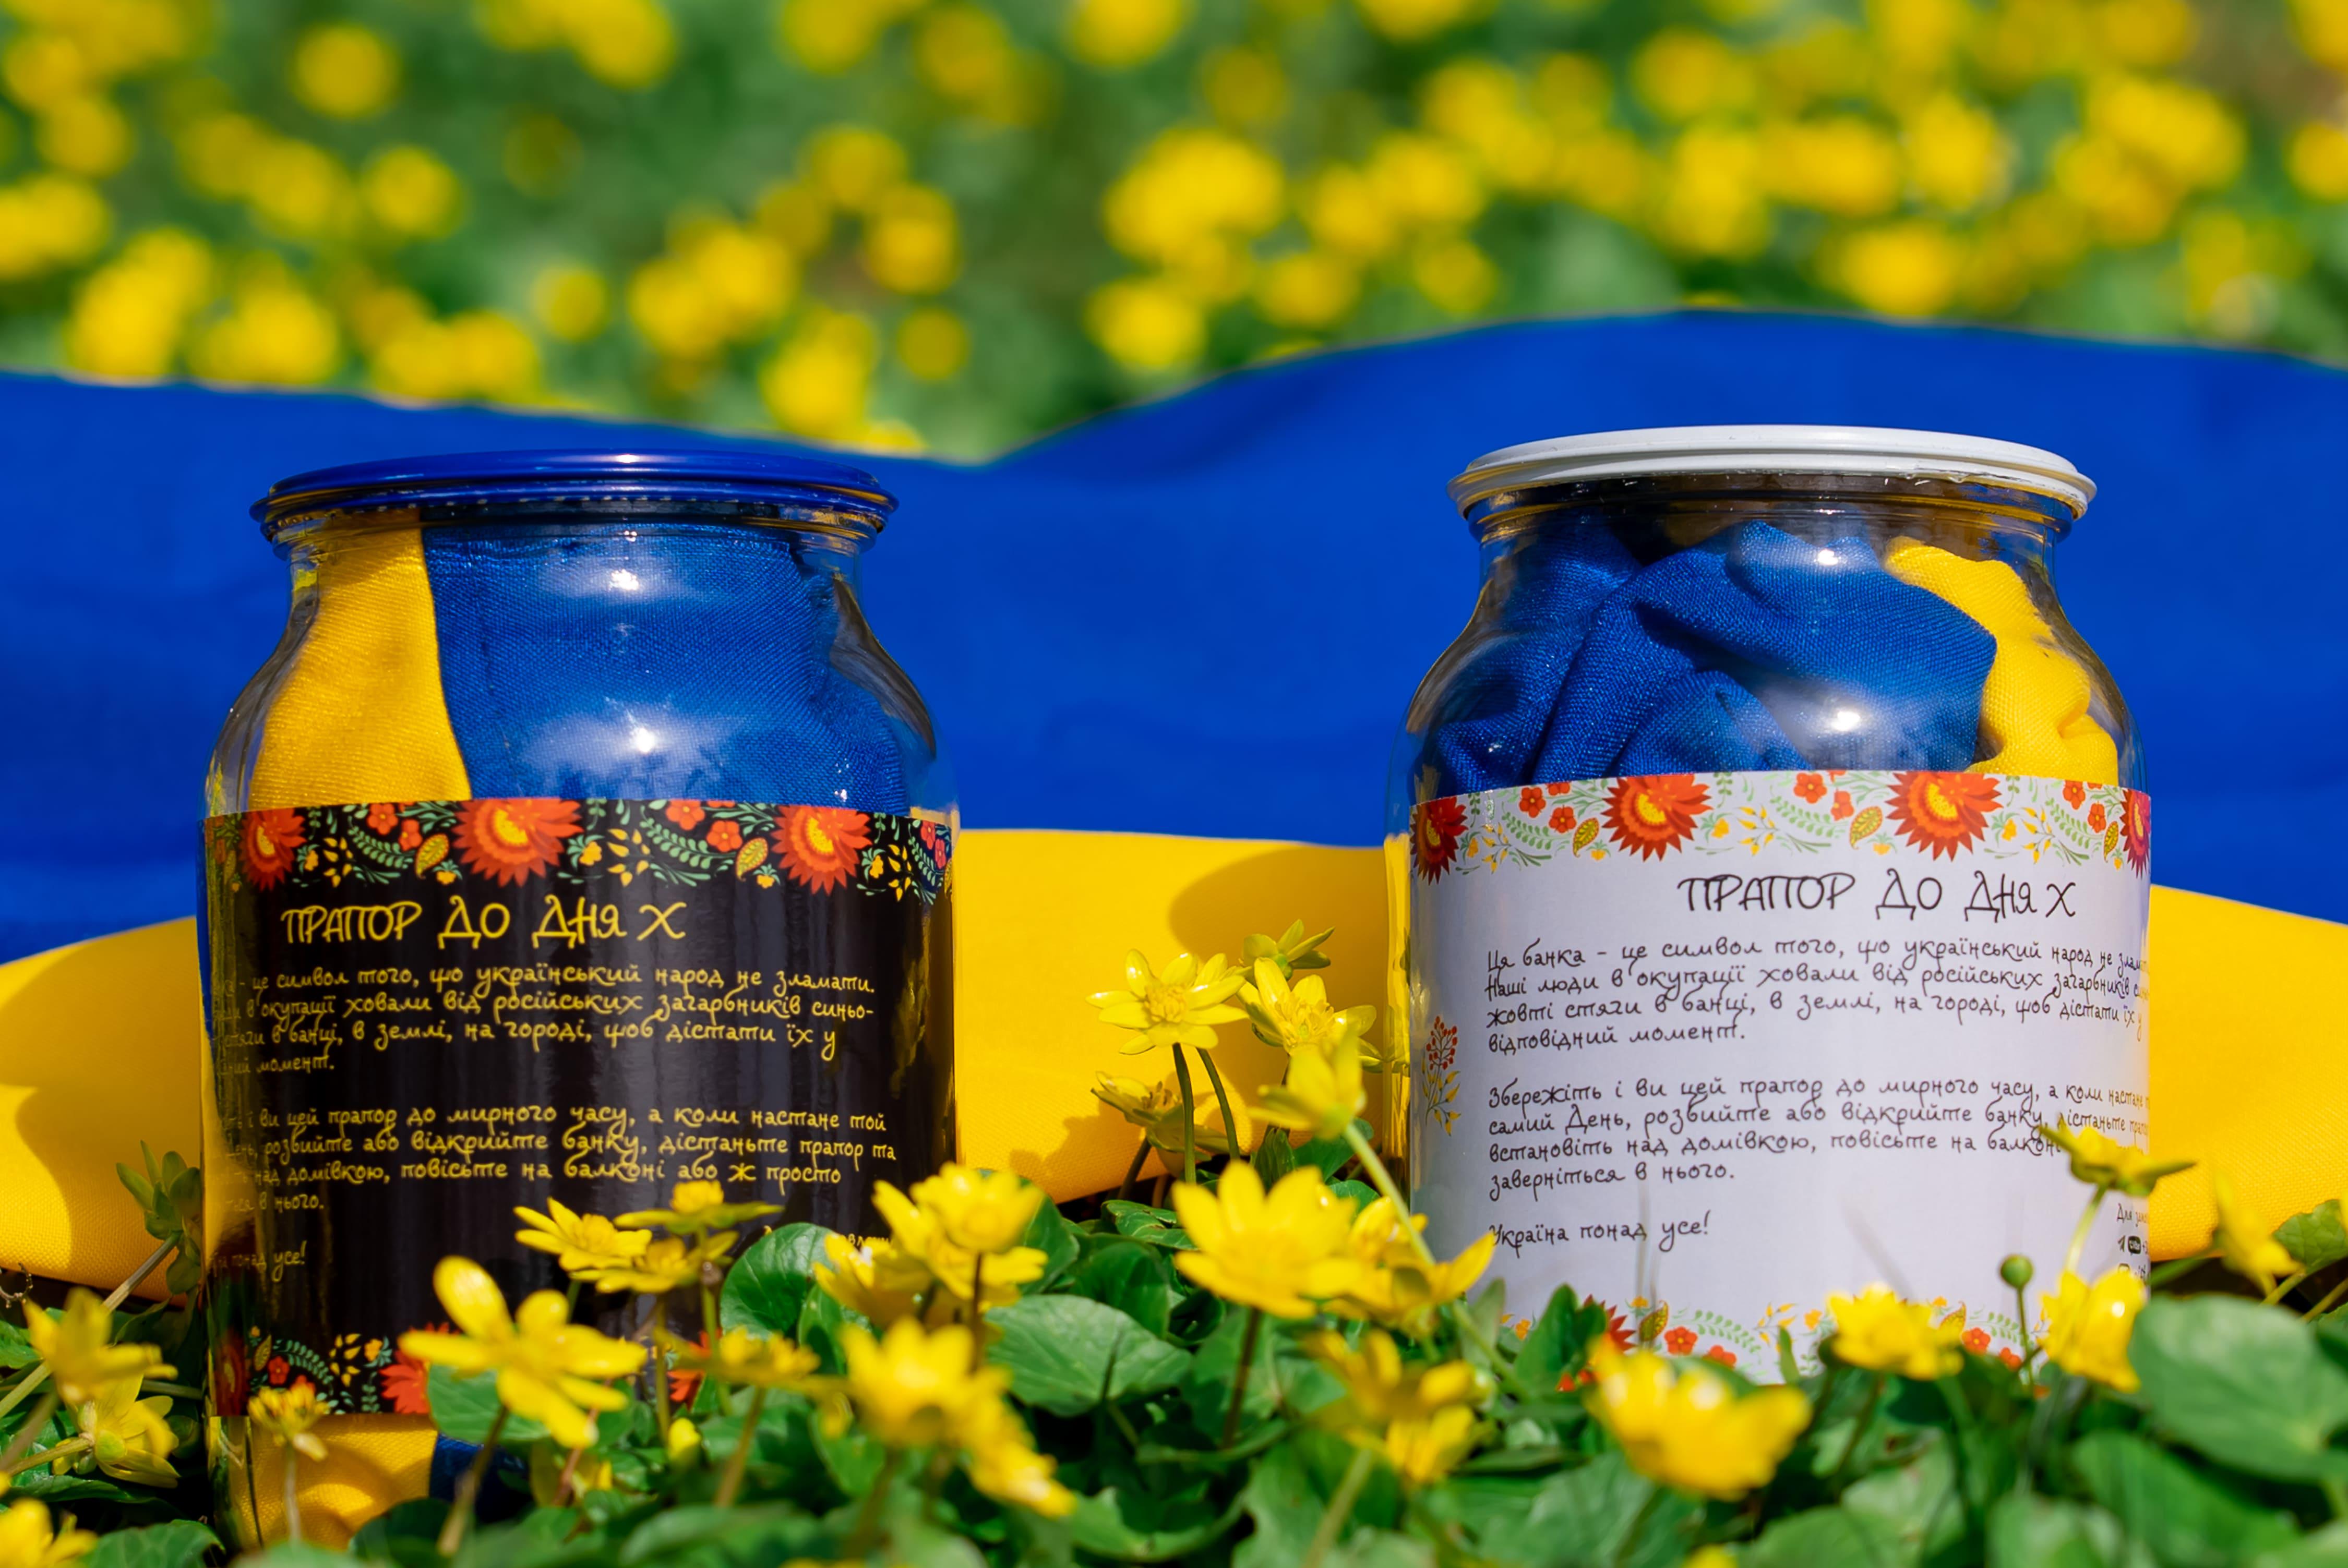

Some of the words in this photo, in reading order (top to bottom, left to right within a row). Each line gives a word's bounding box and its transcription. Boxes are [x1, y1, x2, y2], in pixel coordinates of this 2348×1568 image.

[1678, 873, 1855, 911] ПРАПОР
[1876, 867, 1943, 920] ДО
[2046, 882, 2076, 918] Х
[281, 901, 422, 944] ПРАПОР
[437, 895, 510, 949] ДО
[637, 902, 687, 941] Х
[1488, 950, 1515, 983] Ця
[1523, 937, 1586, 968] банка
[1621, 946, 1648, 975] це
[1662, 936, 1762, 958] символ
[1774, 938, 1844, 959] того,
[1858, 940, 1890, 963] що
[1904, 938, 2042, 971] український
[2052, 945, 2093, 974] народ
[2100, 951, 2113, 969] не
[253, 977, 269, 1006] це
[276, 967, 349, 988] символ
[357, 968, 419, 987] того,
[429, 969, 463, 993] що
[476, 963, 641, 999] український
[655, 968, 724, 998] народ
[737, 970, 762, 990] не
[773, 970, 874, 997] зламати.
[1484, 974, 1526, 1002] Наші
[1537, 975, 1599, 994] люди
[1611, 968, 1624, 987] в
[1636, 965, 1745, 1002] окупації
[1756, 963, 1859, 987] ховали
[1873, 963, 1909, 984] від
[1922, 966, 2043, 996] російських
[2054, 965, 2129, 1005] загарбників
[261, 995, 335, 1032] окупації
[342, 994, 432, 1018] ховали
[443, 991, 480, 1014] від
[493, 989, 643, 1024] російських
[658, 983, 801, 1026] загарбників
[811, 1002, 873, 1022] синьо-
[1487, 1002, 1553, 1029] жовті
[1565, 1000, 1642, 1018] стяги
[1655, 994, 1667, 1012] в
[1682, 985, 1756, 1025] банці,
[1770, 991, 1782, 1010] в
[1796, 992, 1880, 1020] землі,
[1894, 994, 1922, 1011] на
[1934, 994, 2006, 1024] городі,
[2016, 986, 2057, 1023] щоб
[2059, 999, 2119, 1021] дістати
[2123, 1005, 2135, 1028] їх
[271, 1024, 281, 1043] в
[289, 1015, 343, 1056] банці,
[352, 1020, 365, 1041] в
[373, 1020, 453, 1051] землі,
[464, 1021, 495, 1039] на
[503, 1019, 592, 1053] городі,
[604, 1009, 663, 1047] щоб
[666, 1020, 776, 1042] дістати
[786, 1024, 813, 1047] їх
[821, 1029, 836, 1062] у
[1488, 1026, 1618, 1056] відповідний
[1629, 1024, 1745, 1043] момент.
[257, 1055, 334, 1074] момент.
[1489, 1077, 1602, 1119] Збережіть
[1615, 1081, 1623, 1098] і
[1636, 1078, 1667, 1097] ви
[1680, 1077, 1727, 1106] цей
[1740, 1079, 1823, 1107] прапор
[1836, 1078, 1865, 1096] до
[1879, 1079, 1979, 1107] мирного
[1991, 1081, 2040, 1111] часу,
[2049, 1085, 2059, 1099] а
[2066, 1084, 2103, 1104] коли
[1489, 1113, 1555, 1135] самий
[1565, 1103, 1631, 1133] День,
[1644, 1093, 1770, 1139] розбийте
[1786, 1096, 1826, 1121] або
[1841, 1102, 1973, 1135] відкрийте
[259, 1108, 280, 1127] ви
[287, 1108, 319, 1136] цей
[328, 1108, 397, 1139] прапор
[406, 1107, 436, 1126] до
[447, 1105, 557, 1136] мирного
[570, 1106, 636, 1138] часу,
[648, 1109, 663, 1124] а
[674, 1107, 739, 1128] коли
[751, 1109, 840, 1131] настане
[850, 1113, 887, 1132] той
[265, 1126, 352, 1170] розбийте
[363, 1123, 399, 1151] або
[411, 1131, 548, 1163] відкрийте
[562, 1121, 647, 1166] банку,
[658, 1133, 788, 1154] дістаньте
[800, 1138, 864, 1171] прапор
[872, 1144, 896, 1161] та
[1488, 1138, 1613, 1163] встановіть
[1626, 1138, 1669, 1156] над
[1681, 1131, 1817, 1154] домівкою,
[1831, 1130, 1937, 1149] повісьте
[1951, 1136, 1976, 1153] на
[287, 1161, 390, 1185] домівкою,
[401, 1160, 508, 1179] повісьте
[522, 1162, 553, 1181] на
[563, 1149, 664, 1183] балконі
[678, 1150, 717, 1179] або
[727, 1164, 757, 1182] ж
[766, 1164, 841, 1196] просто
[1489, 1167, 1625, 1201] заверніться
[1635, 1162, 1647, 1180] в
[1662, 1164, 1734, 1184] нього.
[259, 1191, 267, 1210] в
[274, 1193, 325, 1213] нього.
[1488, 1223, 1569, 1258] Україна
[1580, 1223, 1648, 1240] понад
[1658, 1210, 1712, 1252] усе!
[271, 1240, 307, 1283] усе!
